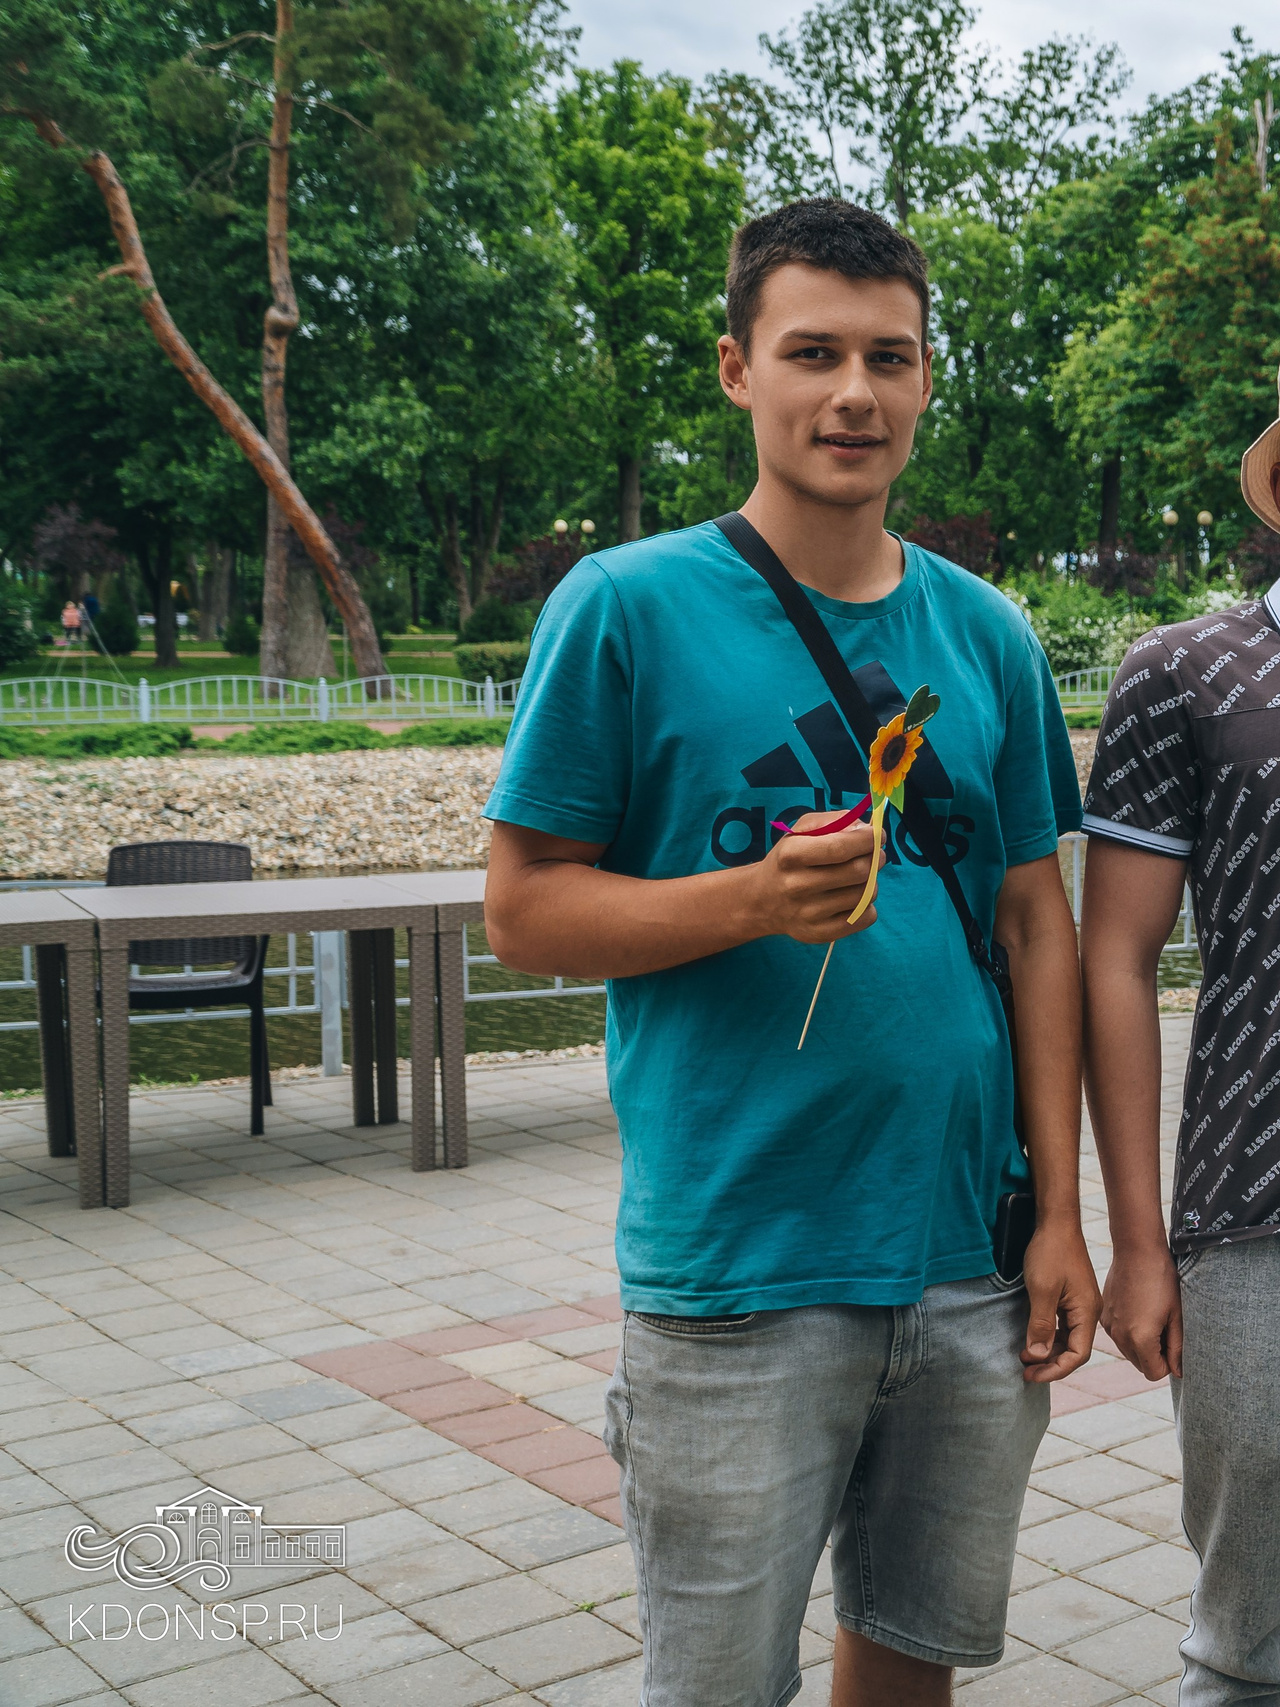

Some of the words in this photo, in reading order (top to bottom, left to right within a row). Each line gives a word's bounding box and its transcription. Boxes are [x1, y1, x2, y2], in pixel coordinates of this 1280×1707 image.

[1191, 622, 1229, 643] LACOSTE
[1115, 668, 1151, 699] LACOSTE
[1201, 650, 1238, 684] LACOSTE
[1105, 714, 1138, 746] LACOSTE
[1103, 757, 1139, 791] LACOSTE
[1227, 787, 1251, 830] LACOSTE
[1203, 838, 1225, 878] LACOSTE
[1225, 832, 1259, 877] LACOSTE
[1222, 975, 1257, 1017] LACOSTE
[1222, 1021, 1257, 1062] LACOSTE
[1218, 1069, 1254, 1110] LACOSTE
